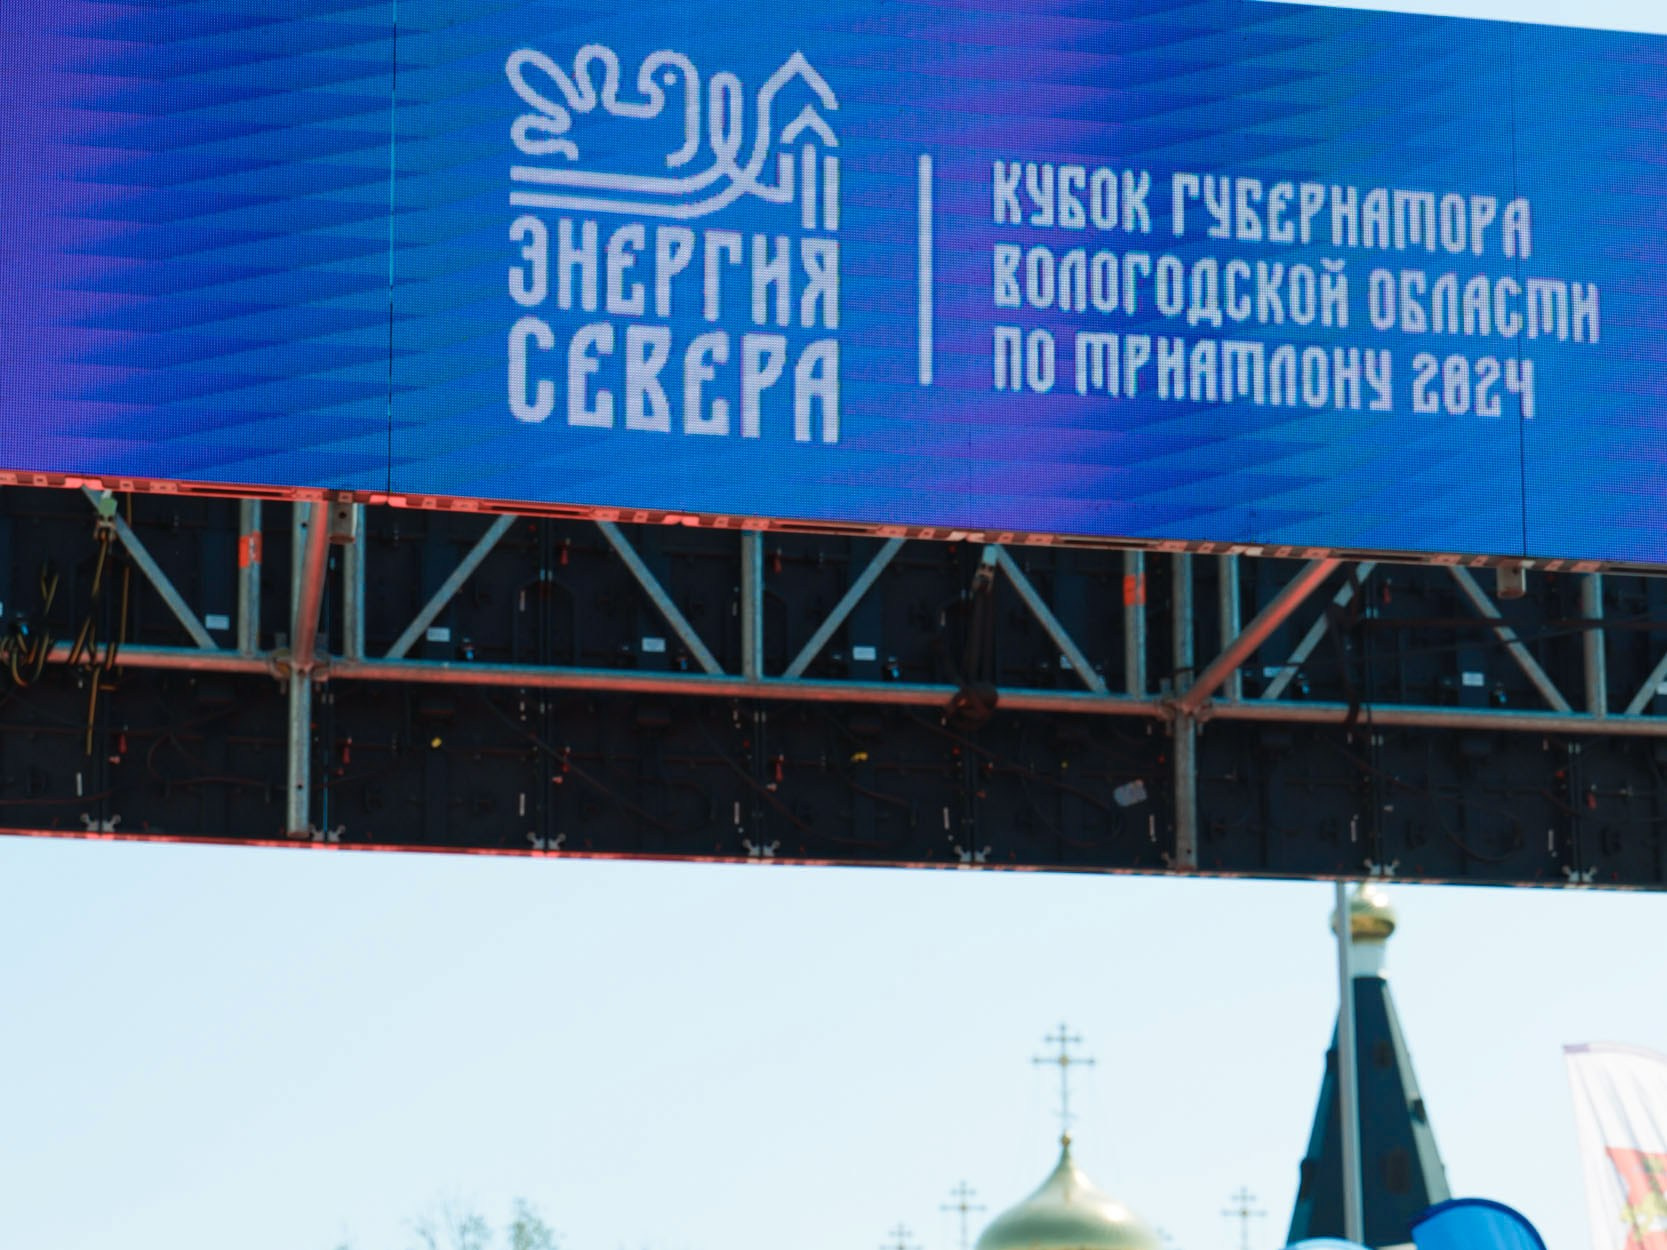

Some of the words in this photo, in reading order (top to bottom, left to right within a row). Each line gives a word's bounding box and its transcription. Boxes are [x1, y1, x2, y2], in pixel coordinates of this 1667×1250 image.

[993, 159, 1151, 234] КУБОК
[1172, 171, 1533, 260] ГУБЕРНАТОРА
[508, 214, 840, 330] ЭНЕРГИЯ
[993, 242, 1350, 328] ВОЛОГОДСКОЙ
[1368, 267, 1600, 344] ОБЛАСТИ
[507, 315, 840, 444] СЕВЕРА
[993, 324, 1055, 393] ПО
[1074, 330, 1394, 412] ТРИАТЛОНУ
[1411, 352, 1535, 420] 2024
